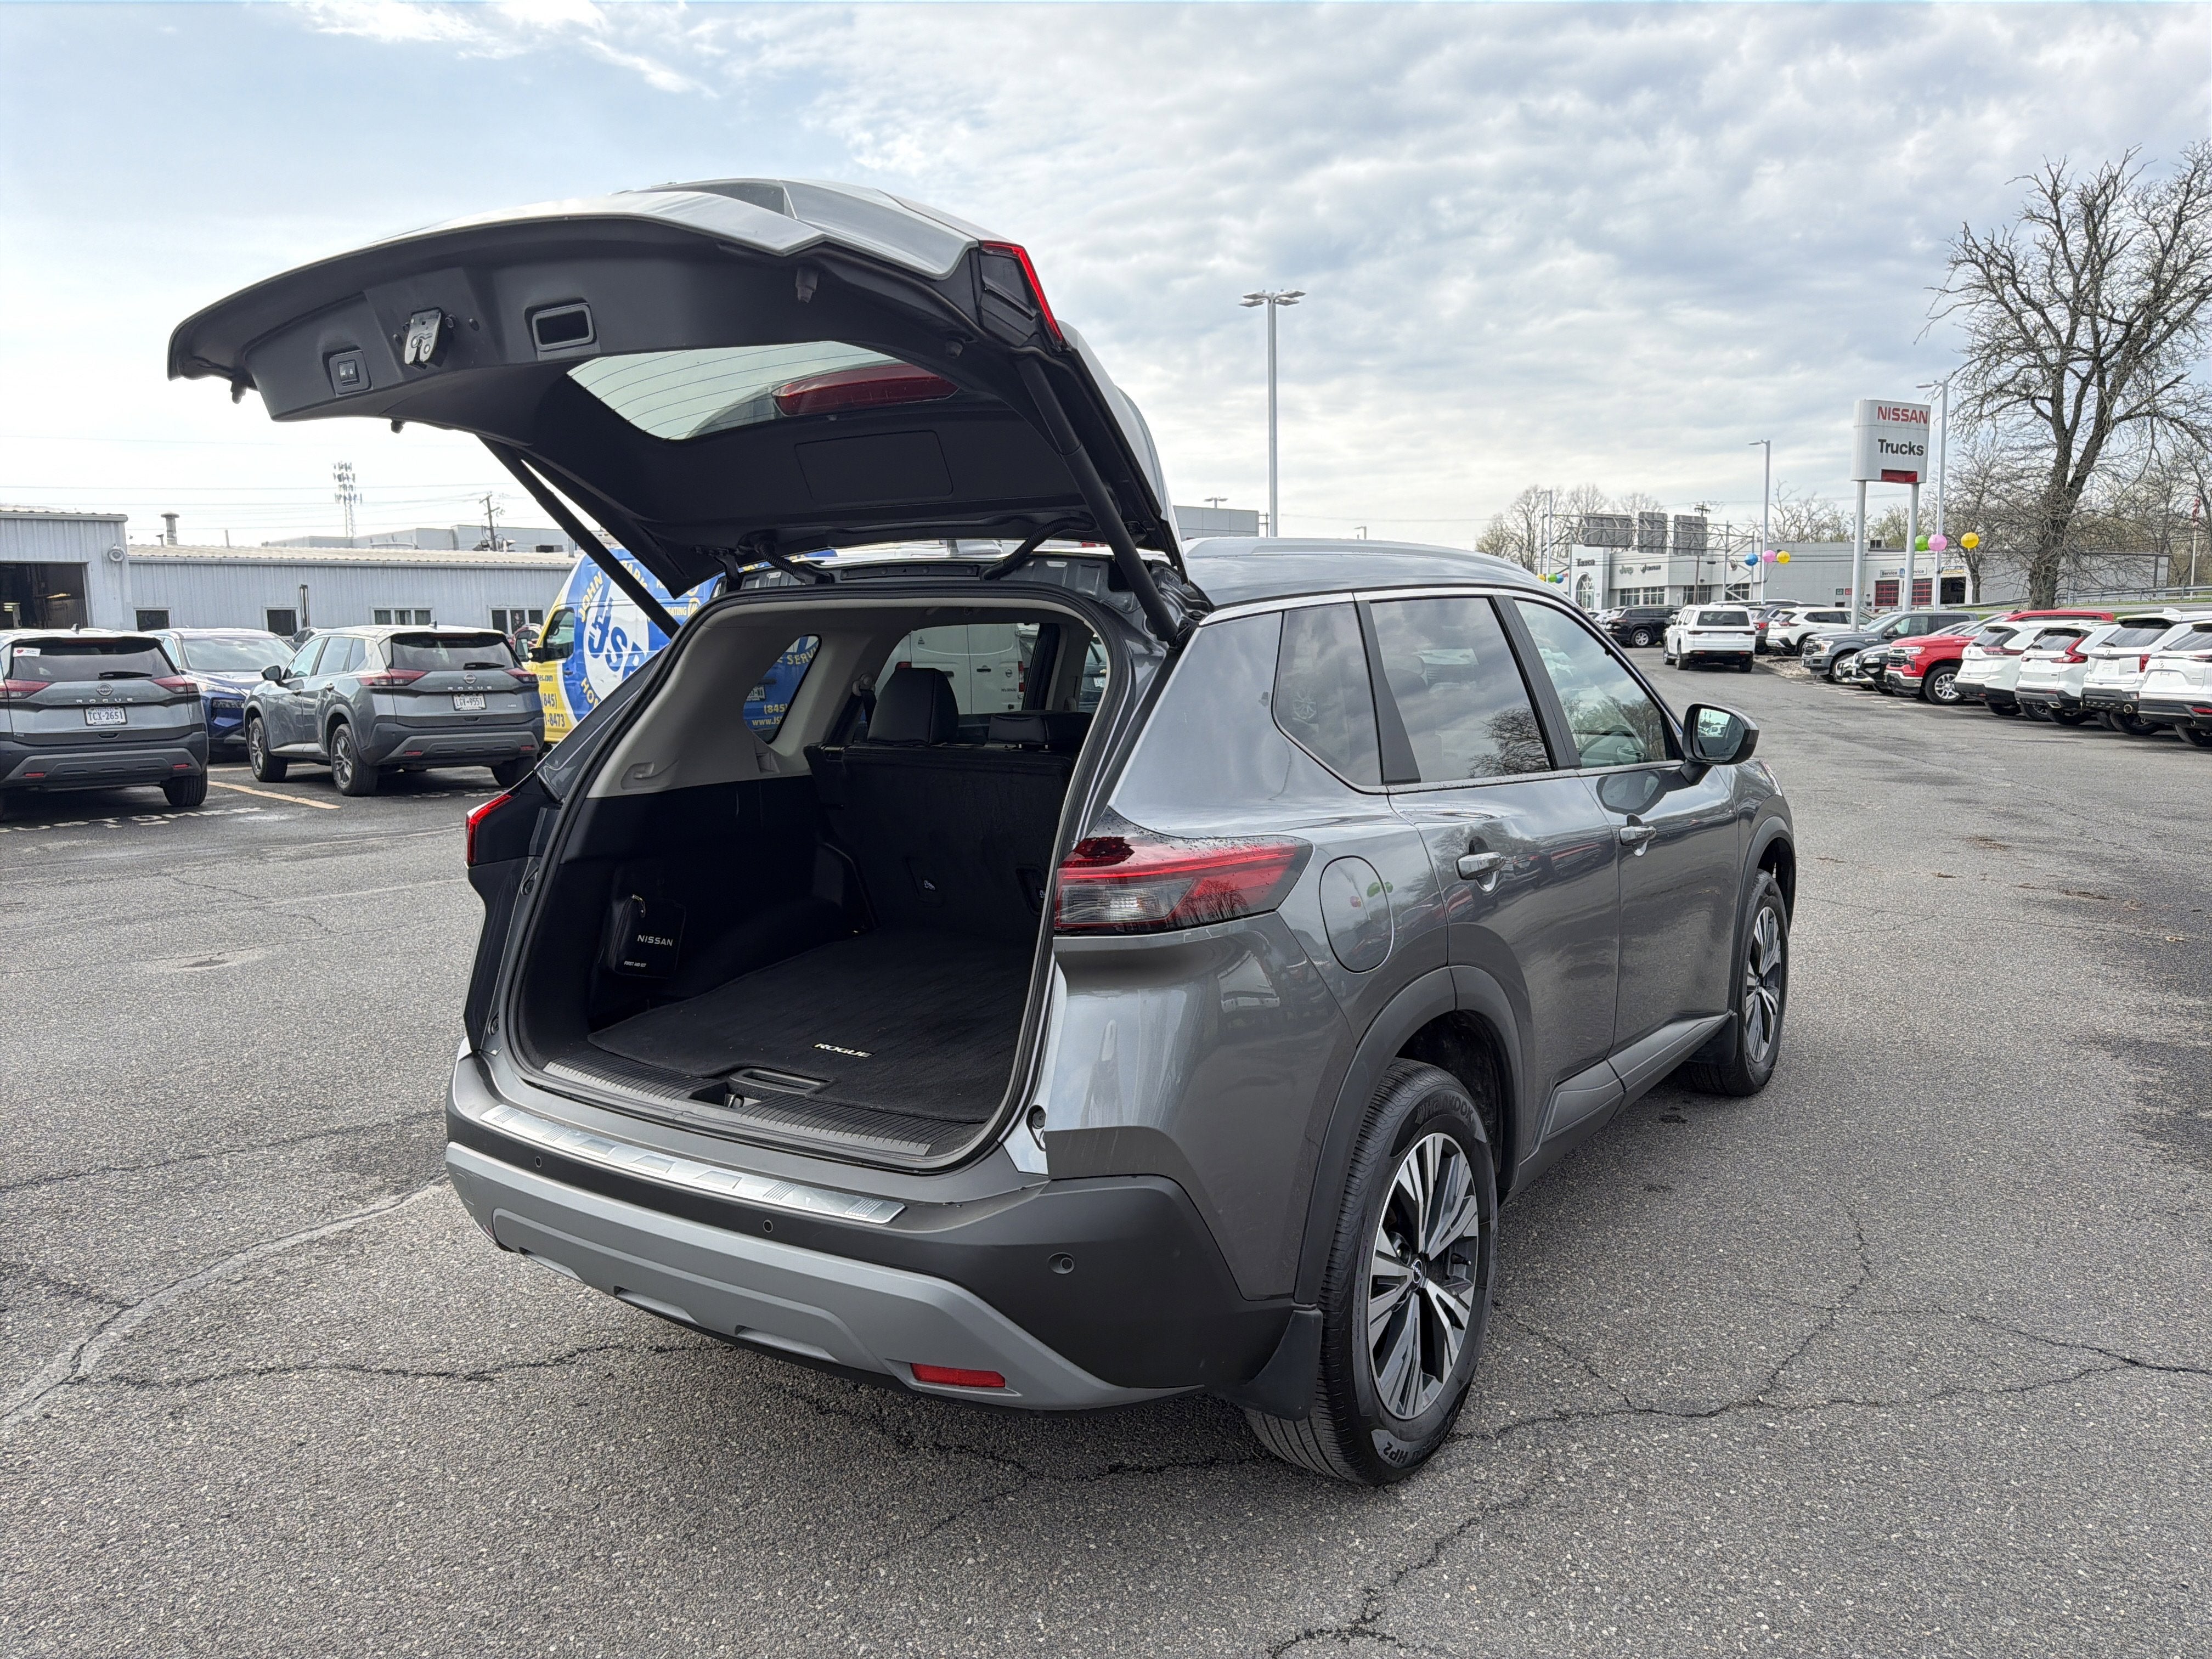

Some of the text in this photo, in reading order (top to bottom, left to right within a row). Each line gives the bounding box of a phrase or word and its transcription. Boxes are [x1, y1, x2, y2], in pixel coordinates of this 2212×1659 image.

[1877, 405, 1928, 425] NISSAN
[1877, 438, 1925, 456] Trucks
[579, 570, 603, 623] JOHN
[541, 692, 557, 709] (845)
[88, 710, 124, 721] TCX-2651
[544, 713, 566, 727] 1-8473
[636, 934, 673, 946] NISSAN
[814, 1043, 873, 1058] ROGUE
[1383, 1440, 1409, 1464] HP2
